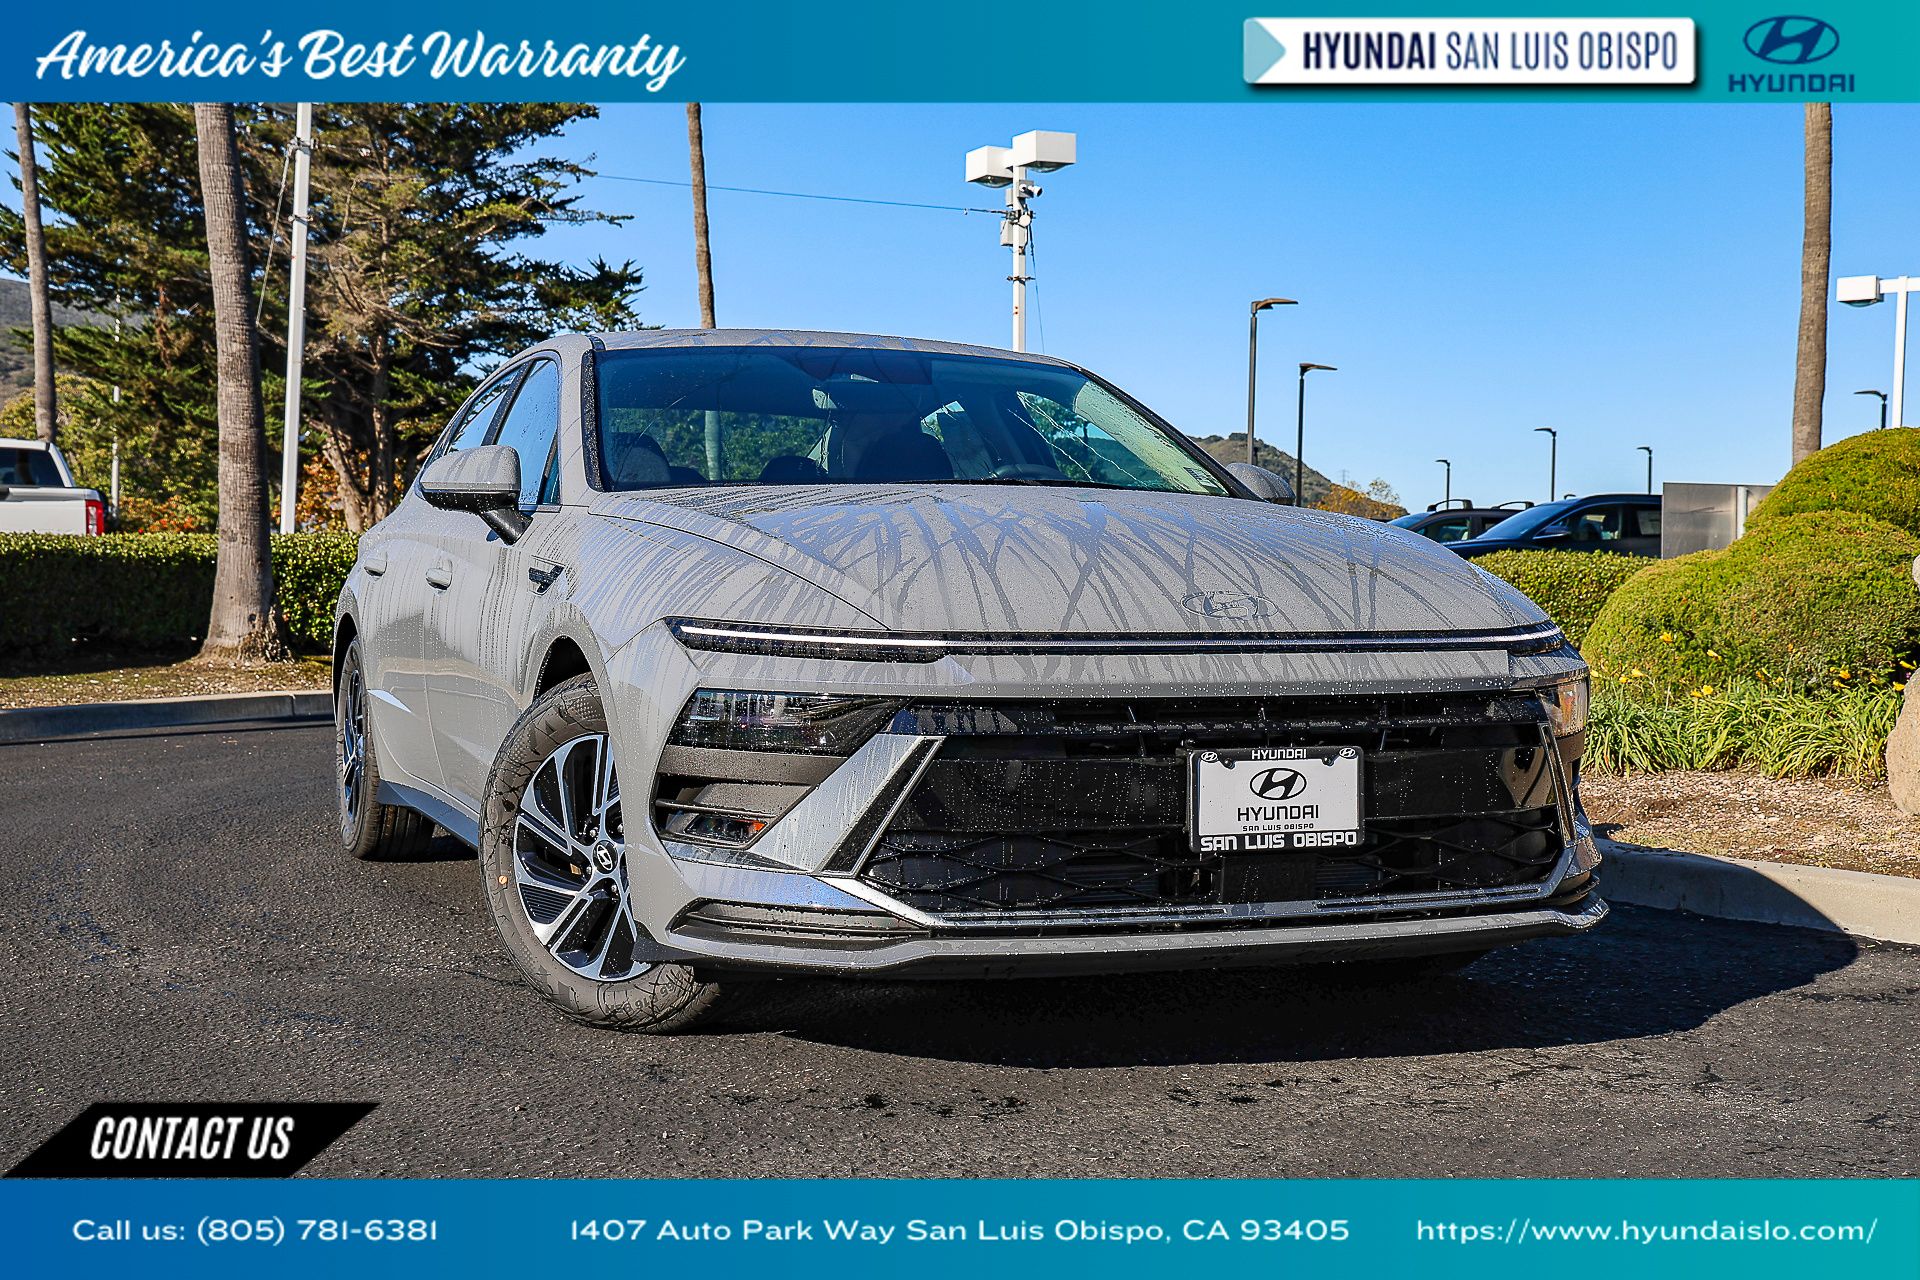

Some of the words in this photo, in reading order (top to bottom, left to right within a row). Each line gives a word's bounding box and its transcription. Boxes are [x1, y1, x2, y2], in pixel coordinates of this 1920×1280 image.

[1251, 748, 1307, 760] HYUNDAI
[1237, 804, 1319, 821] HYUNDAI
[1242, 824, 1260, 832] SAN
[1284, 822, 1314, 830] OBISPO
[1200, 835, 1238, 852] SAN
[1244, 834, 1285, 850] LUIS
[1293, 831, 1357, 848] OBISPO
